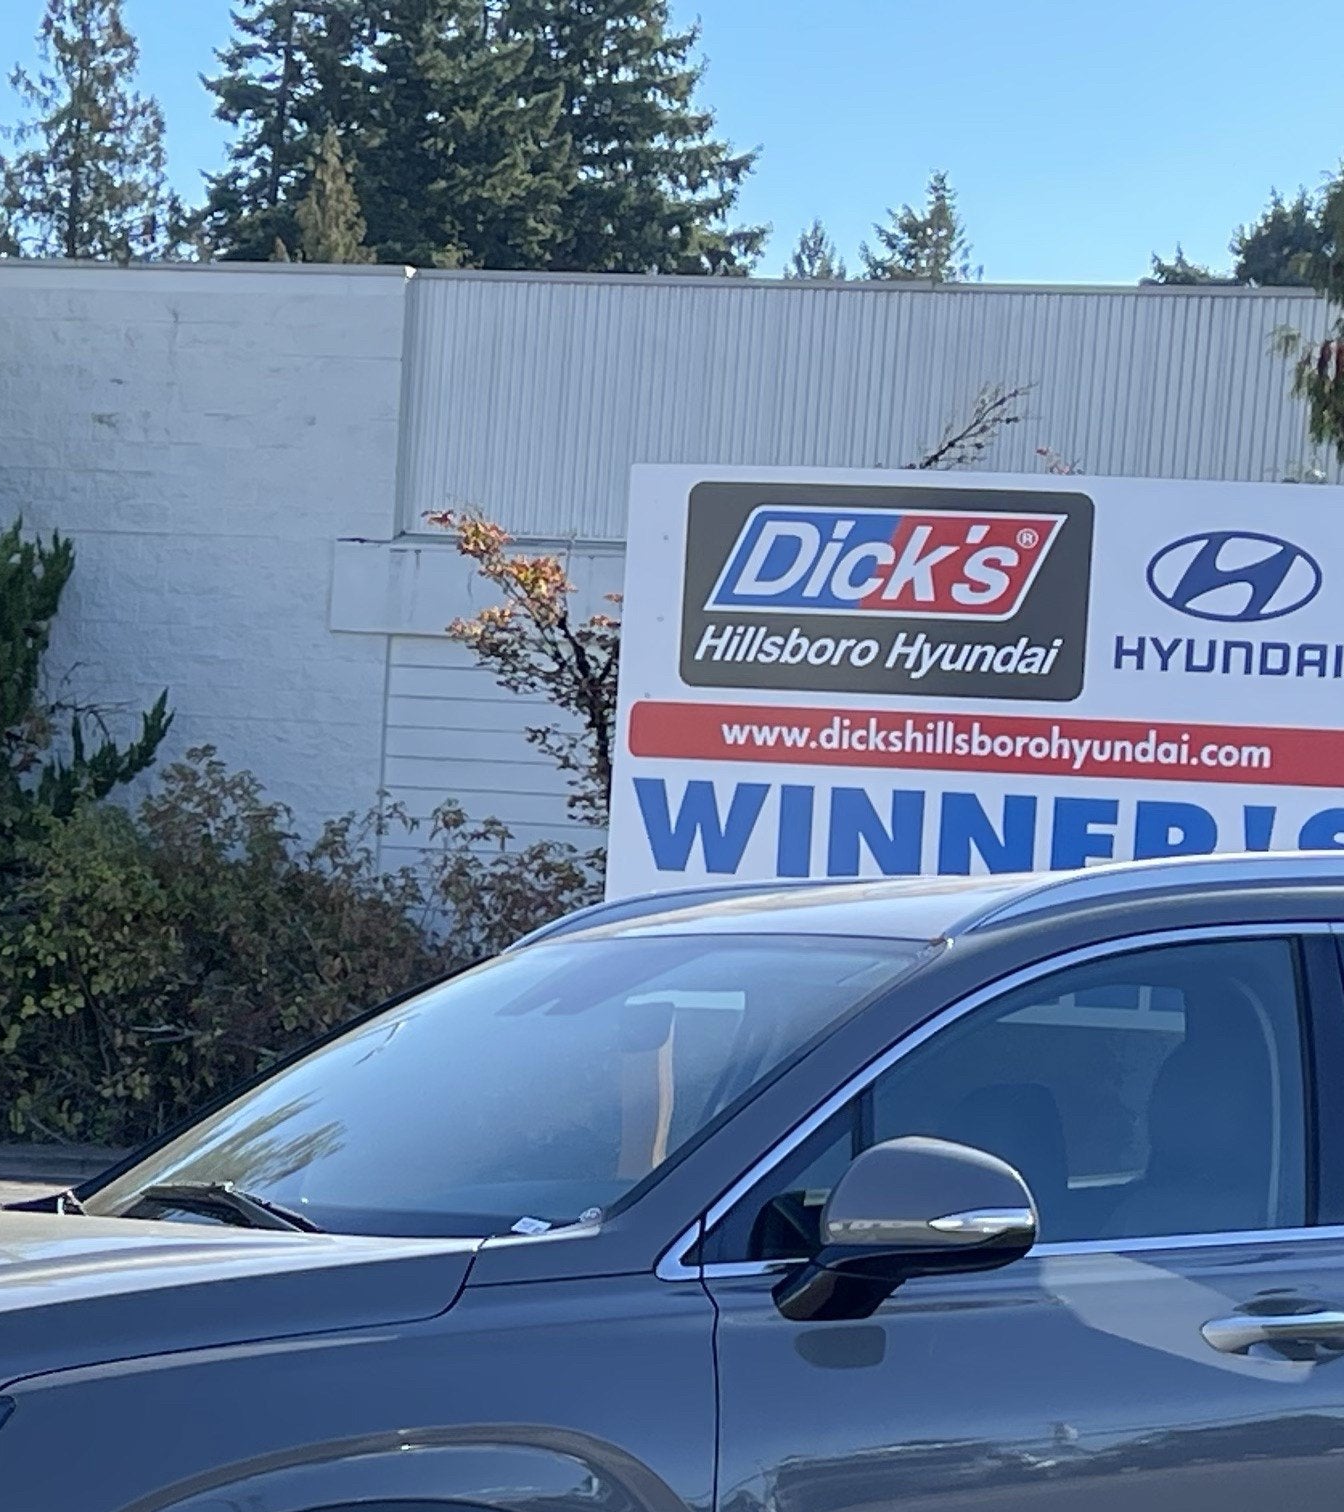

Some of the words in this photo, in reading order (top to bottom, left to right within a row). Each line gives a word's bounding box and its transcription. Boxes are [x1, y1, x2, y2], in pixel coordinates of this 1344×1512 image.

[732, 520, 1020, 606] Dick's
[694, 624, 880, 669] Hillsboro
[885, 632, 1064, 680] Hyundai
[1114, 635, 1344, 679] HYUNDAI
[720, 715, 1272, 769] www.dickshillsborohyundai.com
